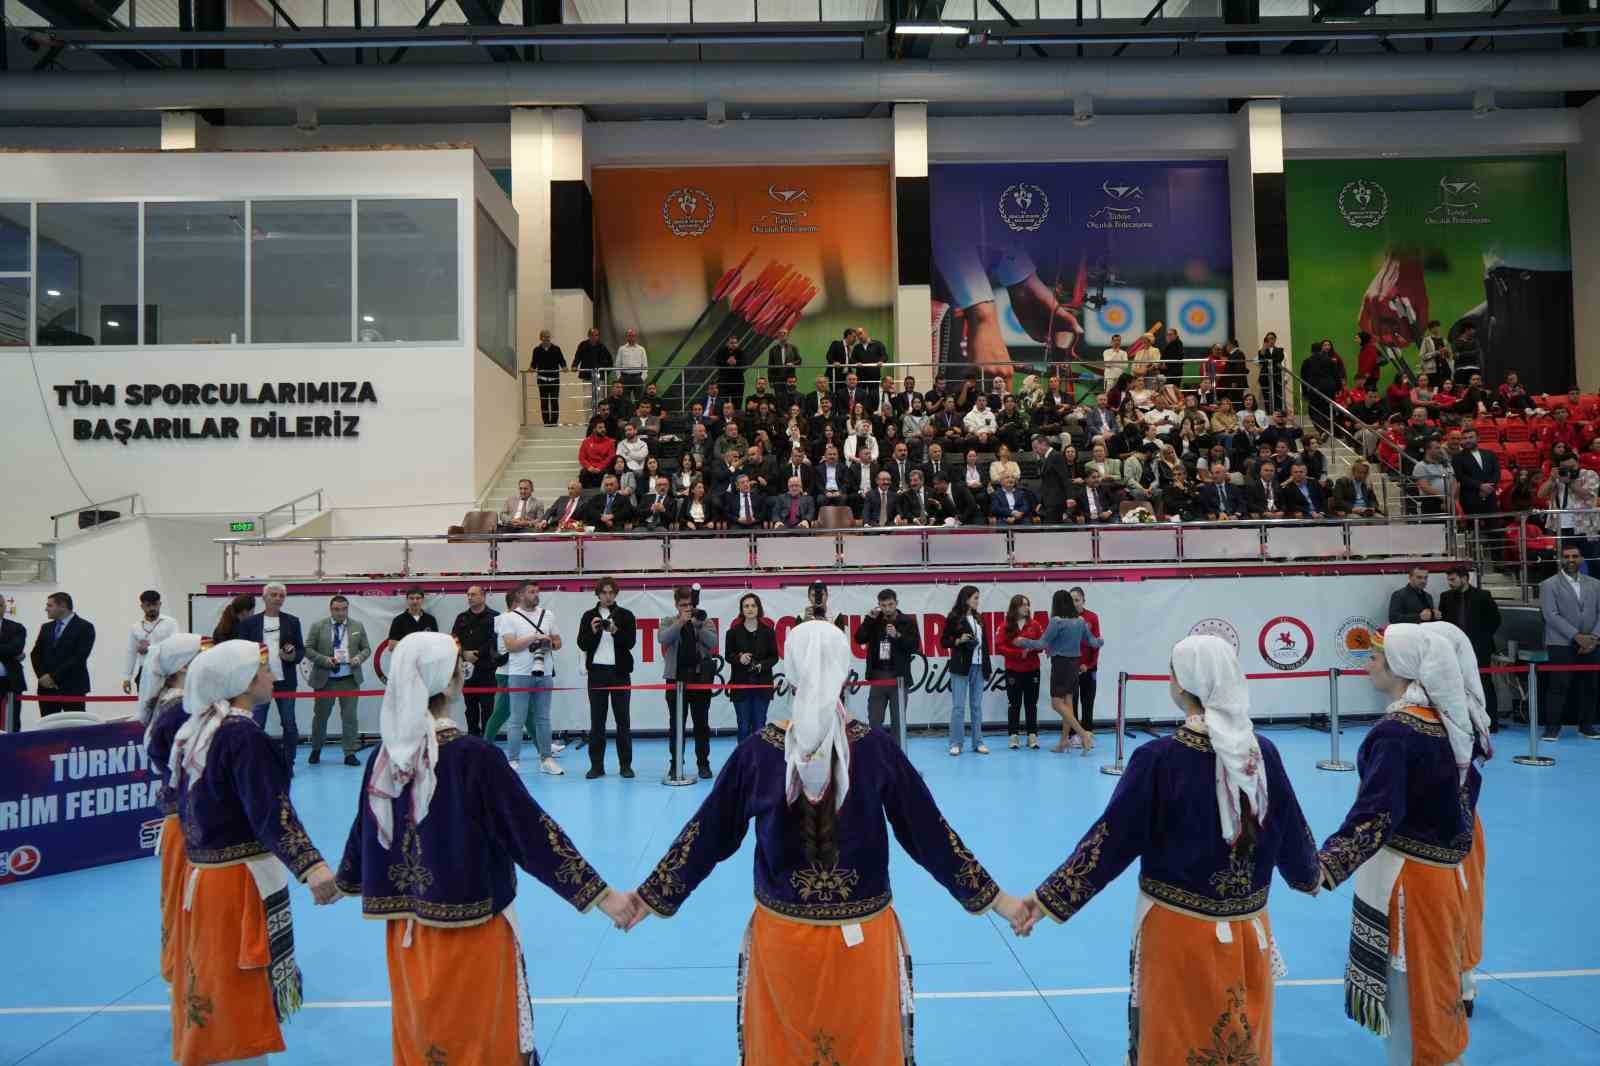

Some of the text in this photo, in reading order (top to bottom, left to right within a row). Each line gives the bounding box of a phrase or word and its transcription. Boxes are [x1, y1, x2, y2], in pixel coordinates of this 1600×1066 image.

[53, 380, 377, 407] TÜM SPORCULARIMIZA
[73, 411, 360, 445] BAŞARILAR DİLERİZ
[50, 740, 148, 782] TÜRKİY
[65, 780, 162, 821] FEDERA
